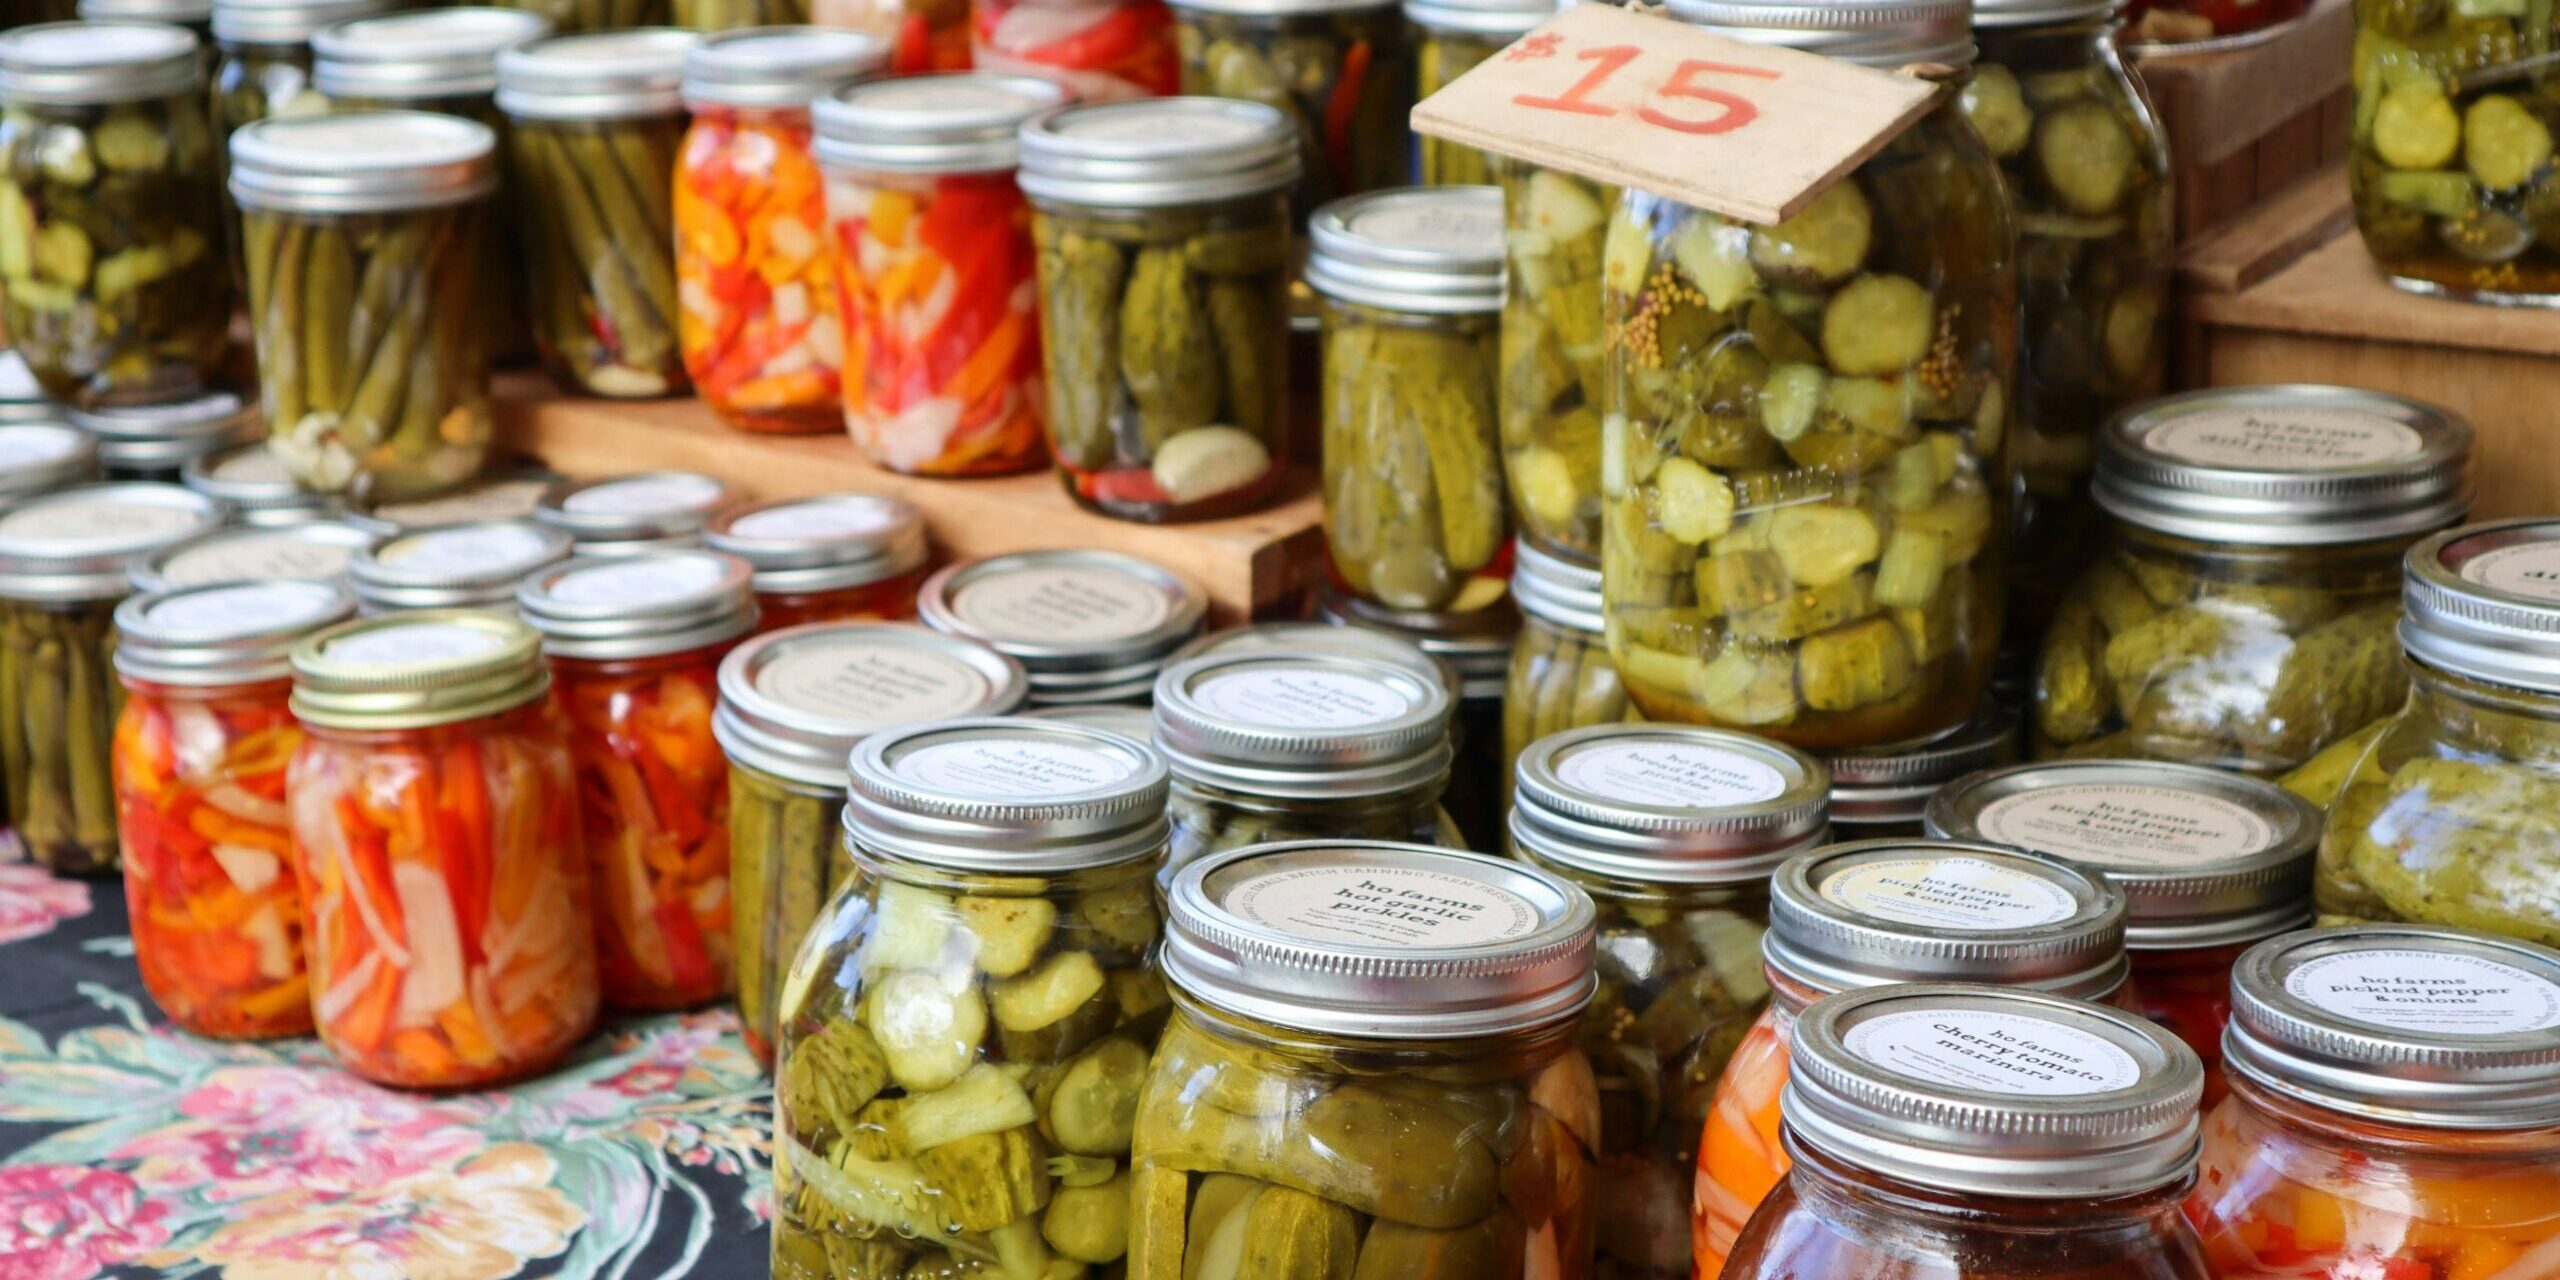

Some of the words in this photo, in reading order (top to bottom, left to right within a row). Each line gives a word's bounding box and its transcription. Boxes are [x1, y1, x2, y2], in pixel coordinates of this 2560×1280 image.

[1504, 32, 1783, 135] $15
[1627, 752, 1682, 774] bread
[1700, 771, 1759, 793] butter
[1639, 768, 1711, 791] pickles
[1667, 753, 1691, 766] ho
[1693, 760, 1751, 781] farms
[2049, 804, 2137, 825] pickled
[2141, 821, 2226, 838] pepper
[2099, 801, 2125, 813] ho
[2130, 808, 2200, 825] farms
[2095, 824, 2173, 840] onions
[1358, 880, 1393, 894] ho
[1397, 889, 1485, 912] farms
[1878, 877, 1959, 898] pickled
[1960, 894, 2036, 911] pepper
[1904, 890, 1917, 898] &
[1920, 896, 1990, 911] onions
[1921, 877, 1946, 886] ho
[1950, 883, 2013, 898] farms
[1329, 902, 1441, 927] pickles
[1334, 888, 1383, 903] hot
[1383, 900, 1475, 922] garlic
[2329, 984, 2421, 994] pickled
[2425, 988, 2511, 997] pepper
[2360, 976, 2390, 984] ho
[2394, 976, 2467, 985] farms
[2375, 994, 2390, 1002] &
[2394, 996, 2478, 1004] onions
[1933, 1023, 2014, 1055] cherry
[2015, 1053, 2105, 1081] tomato
[1936, 1039, 2055, 1081] marinara
[1989, 1030, 2017, 1042] ho
[2018, 1041, 2085, 1064] farms
